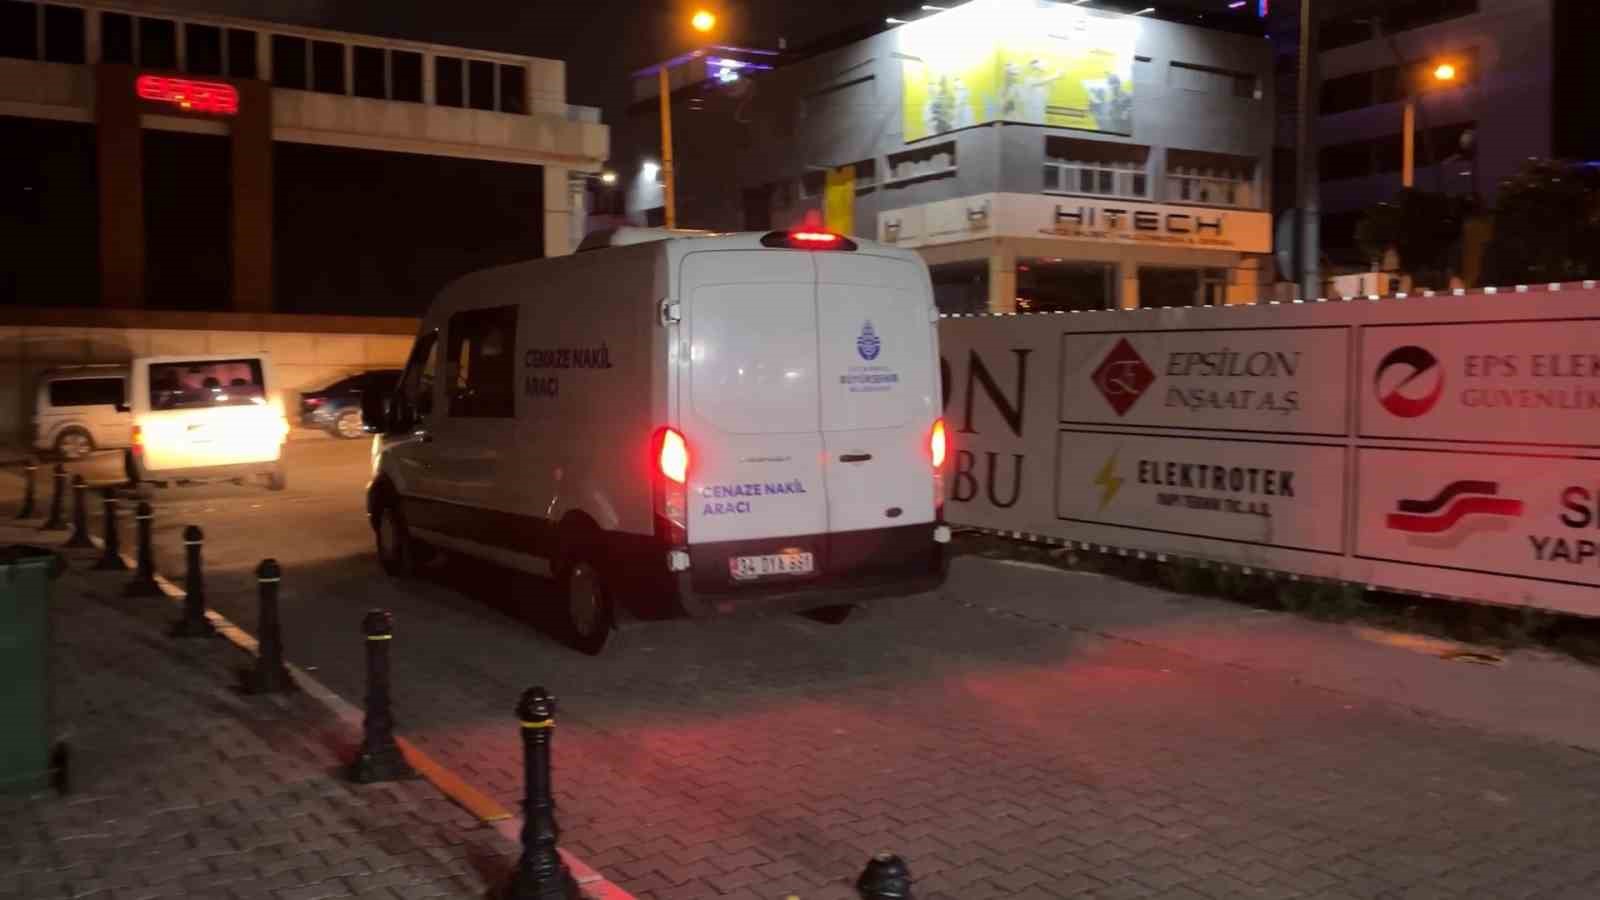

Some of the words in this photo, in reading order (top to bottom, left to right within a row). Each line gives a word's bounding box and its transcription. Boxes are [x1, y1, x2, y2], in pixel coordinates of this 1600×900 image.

[1055, 205, 1222, 236] HITECH
[1464, 354, 1520, 377] EPS
[941, 348, 1034, 438] N
[703, 483, 762, 498] CENAZE
[764, 478, 807, 495] NAKİL
[1138, 459, 1294, 498] ELEKTROTEK
[703, 502, 752, 516] ARACI
[1559, 486, 1600, 530] S
